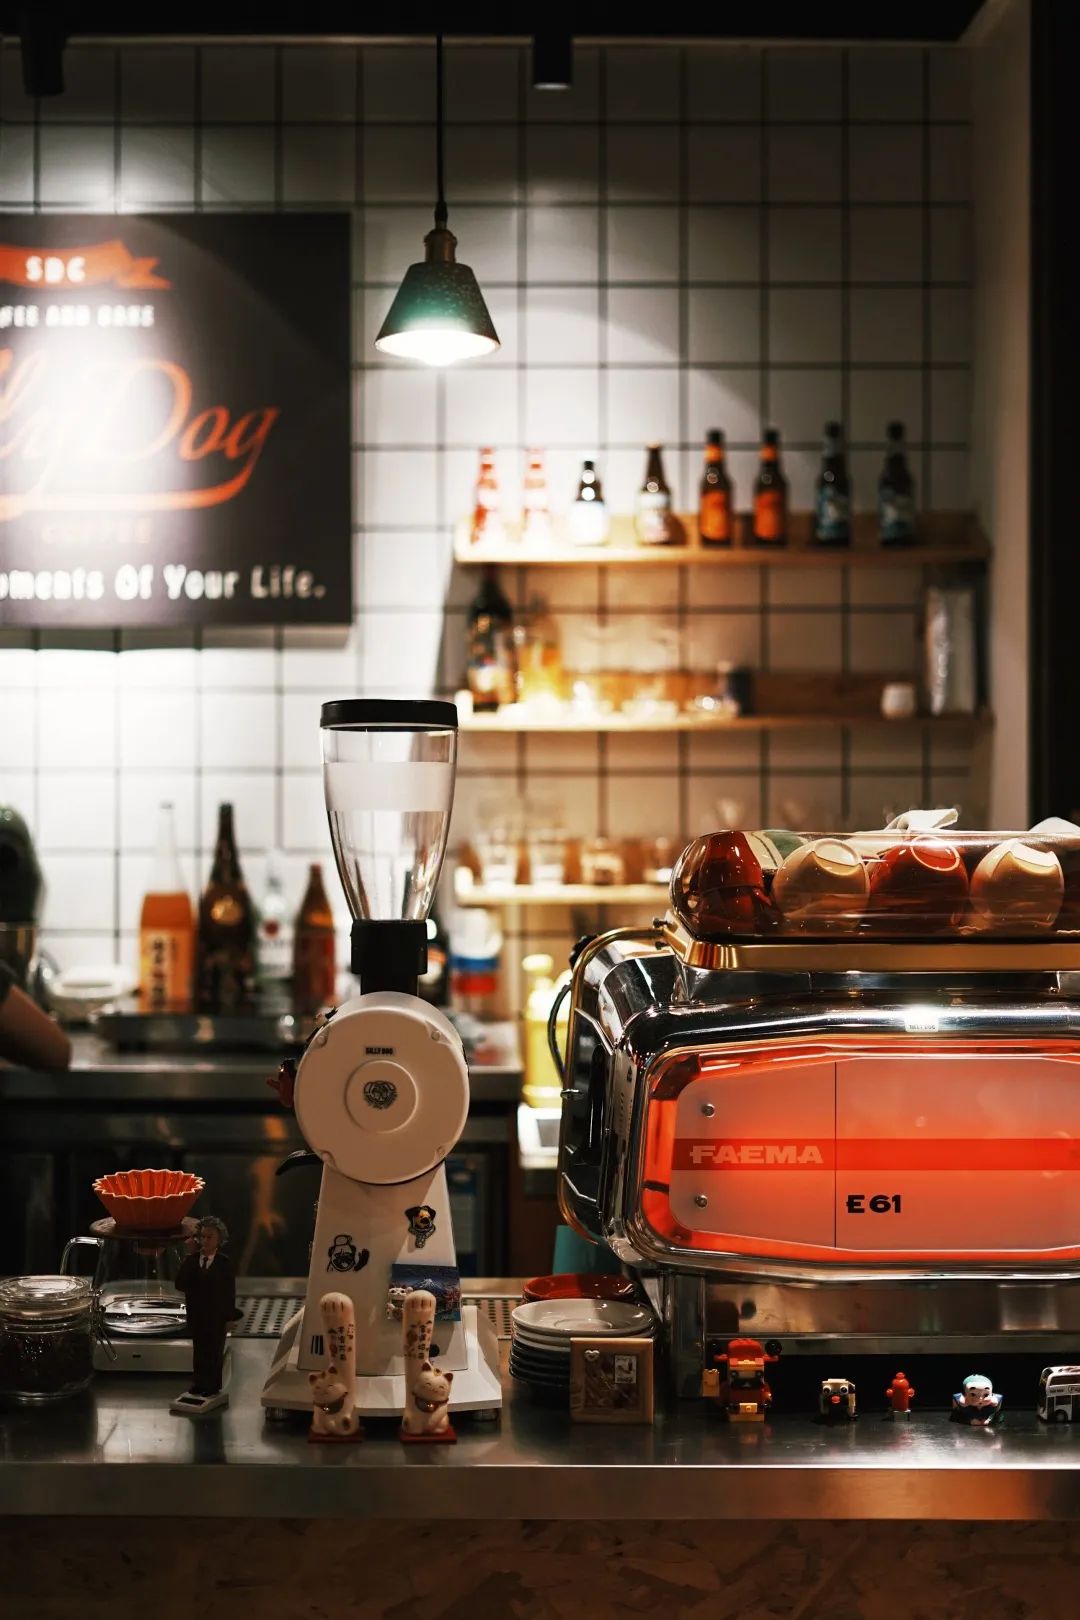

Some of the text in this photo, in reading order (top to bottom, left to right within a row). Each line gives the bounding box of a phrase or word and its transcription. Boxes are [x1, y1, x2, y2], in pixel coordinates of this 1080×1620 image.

[114, 564, 154, 600] Of
[163, 564, 239, 600] Your
[250, 564, 326, 600] Life.
[690, 1145, 824, 1164] FAEMA
